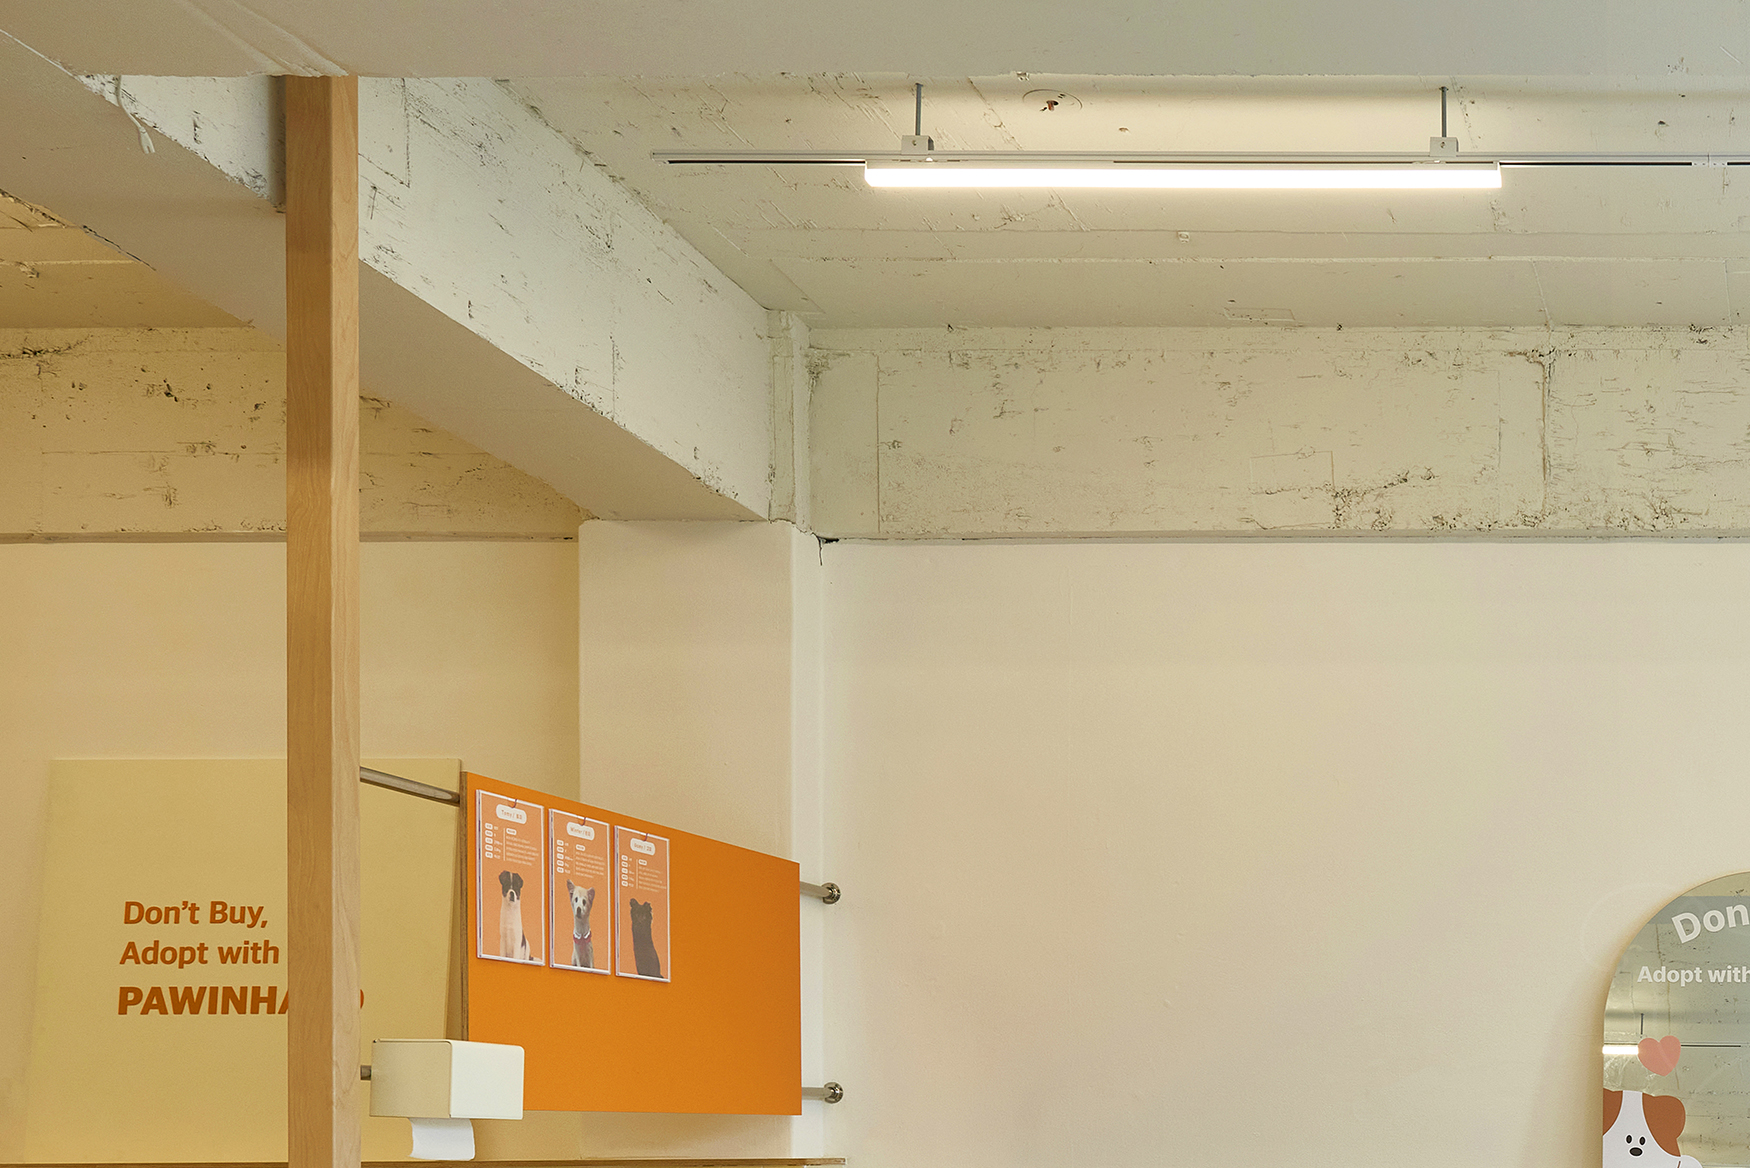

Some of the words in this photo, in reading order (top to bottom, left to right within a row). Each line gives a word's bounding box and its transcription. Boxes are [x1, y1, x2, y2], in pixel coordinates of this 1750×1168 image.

[123, 900, 200, 925] Don't
[208, 900, 268, 928] Buy,
[119, 940, 209, 969] Adopt
[217, 940, 280, 964] with
[1637, 966, 1702, 987] Adopt
[117, 986, 364, 1015] PAWINH
